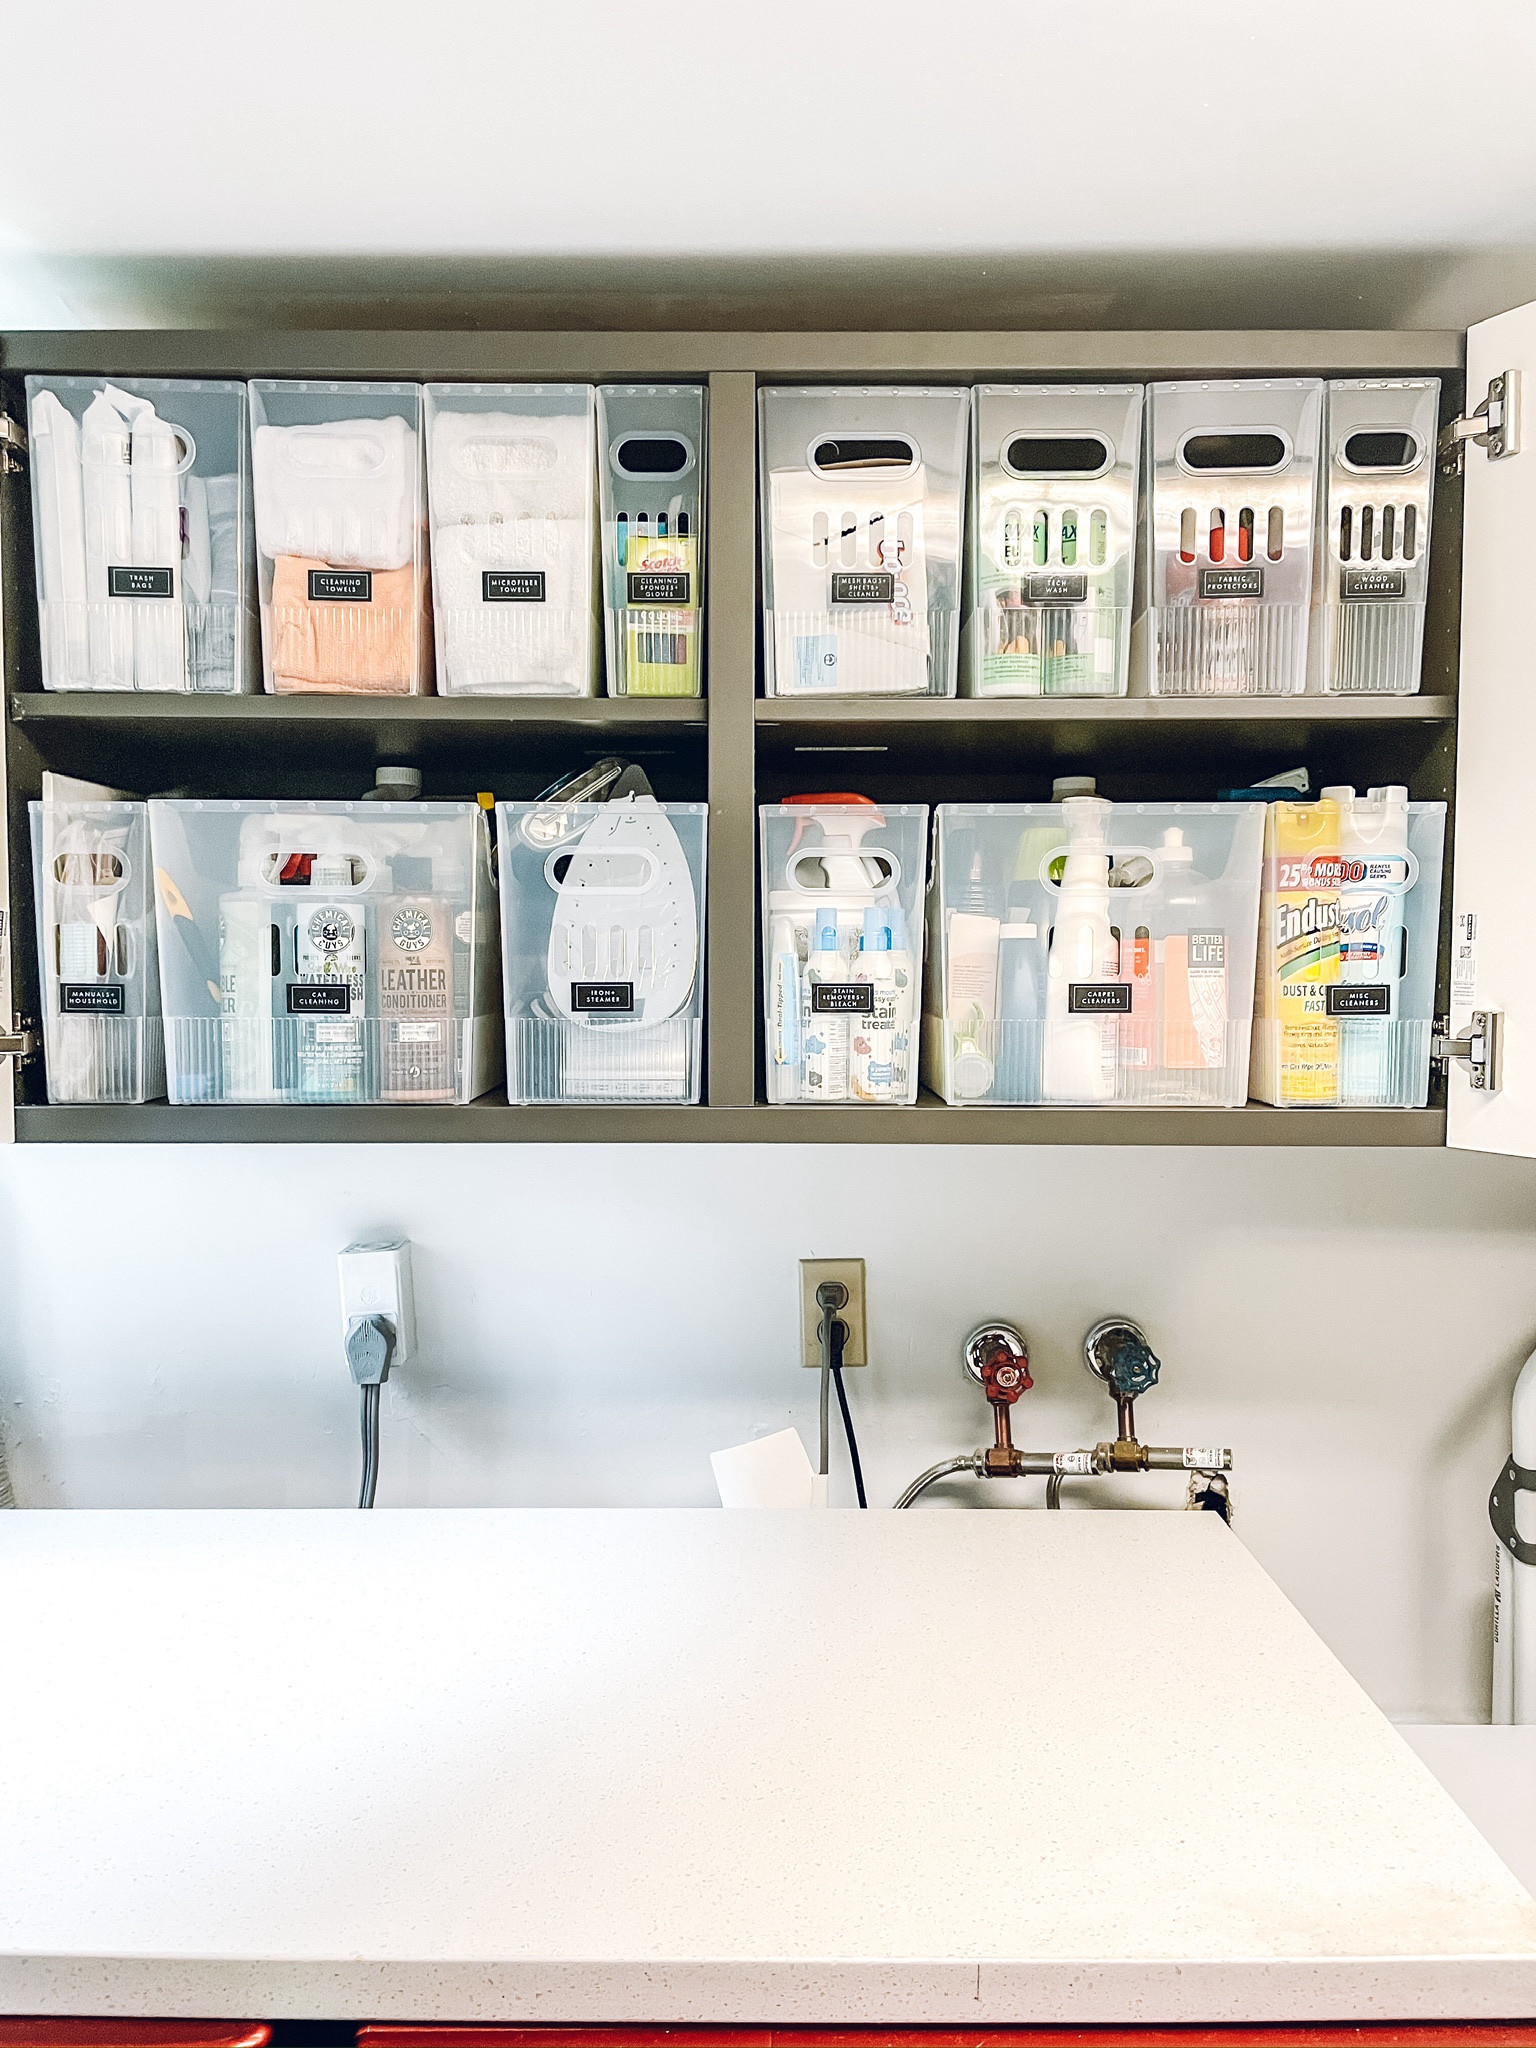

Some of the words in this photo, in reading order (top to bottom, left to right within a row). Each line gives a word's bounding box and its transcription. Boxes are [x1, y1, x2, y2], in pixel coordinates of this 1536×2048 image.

[320, 578, 361, 586] CLEANING
[1207, 582, 1258, 590] PROTECTORS
[392, 907, 431, 932] CHEMICAL
[399, 939, 425, 951] GUYS
[1192, 934, 1224, 945] BETTER
[1192, 945, 1224, 962] LIFE
[381, 968, 446, 991] LEATHER
[1282, 985, 1308, 997] DUST
[1309, 985, 1317, 997] &
[381, 993, 448, 1009] CONDITIONER
